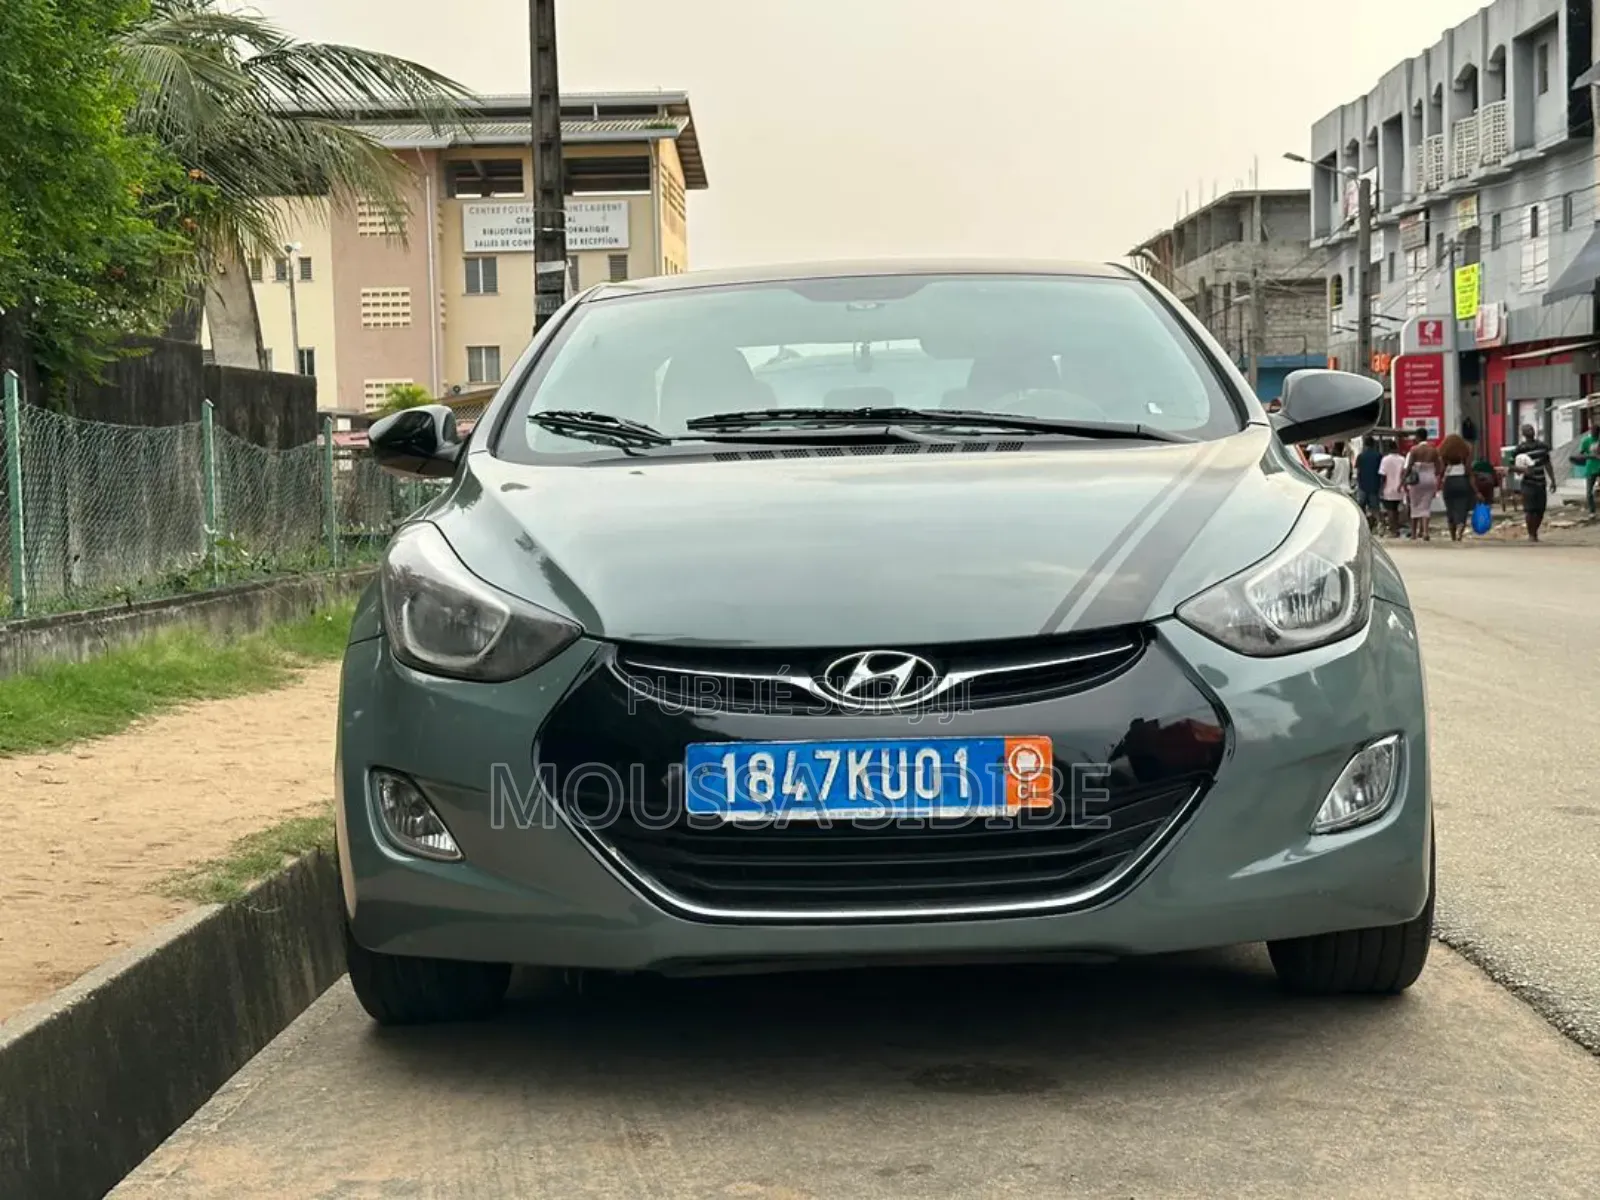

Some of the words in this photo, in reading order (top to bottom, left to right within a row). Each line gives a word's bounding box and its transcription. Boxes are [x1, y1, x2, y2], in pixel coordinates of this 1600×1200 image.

[469, 205, 501, 214] CENTRE
[585, 203, 622, 212] LAURENT
[568, 225, 610, 233] ORMATIQUE
[474, 239, 498, 247] SALLES
[500, 239, 510, 247] DE
[580, 236, 619, 245] RECEPTION
[722, 747, 969, 803] 1847KU01
